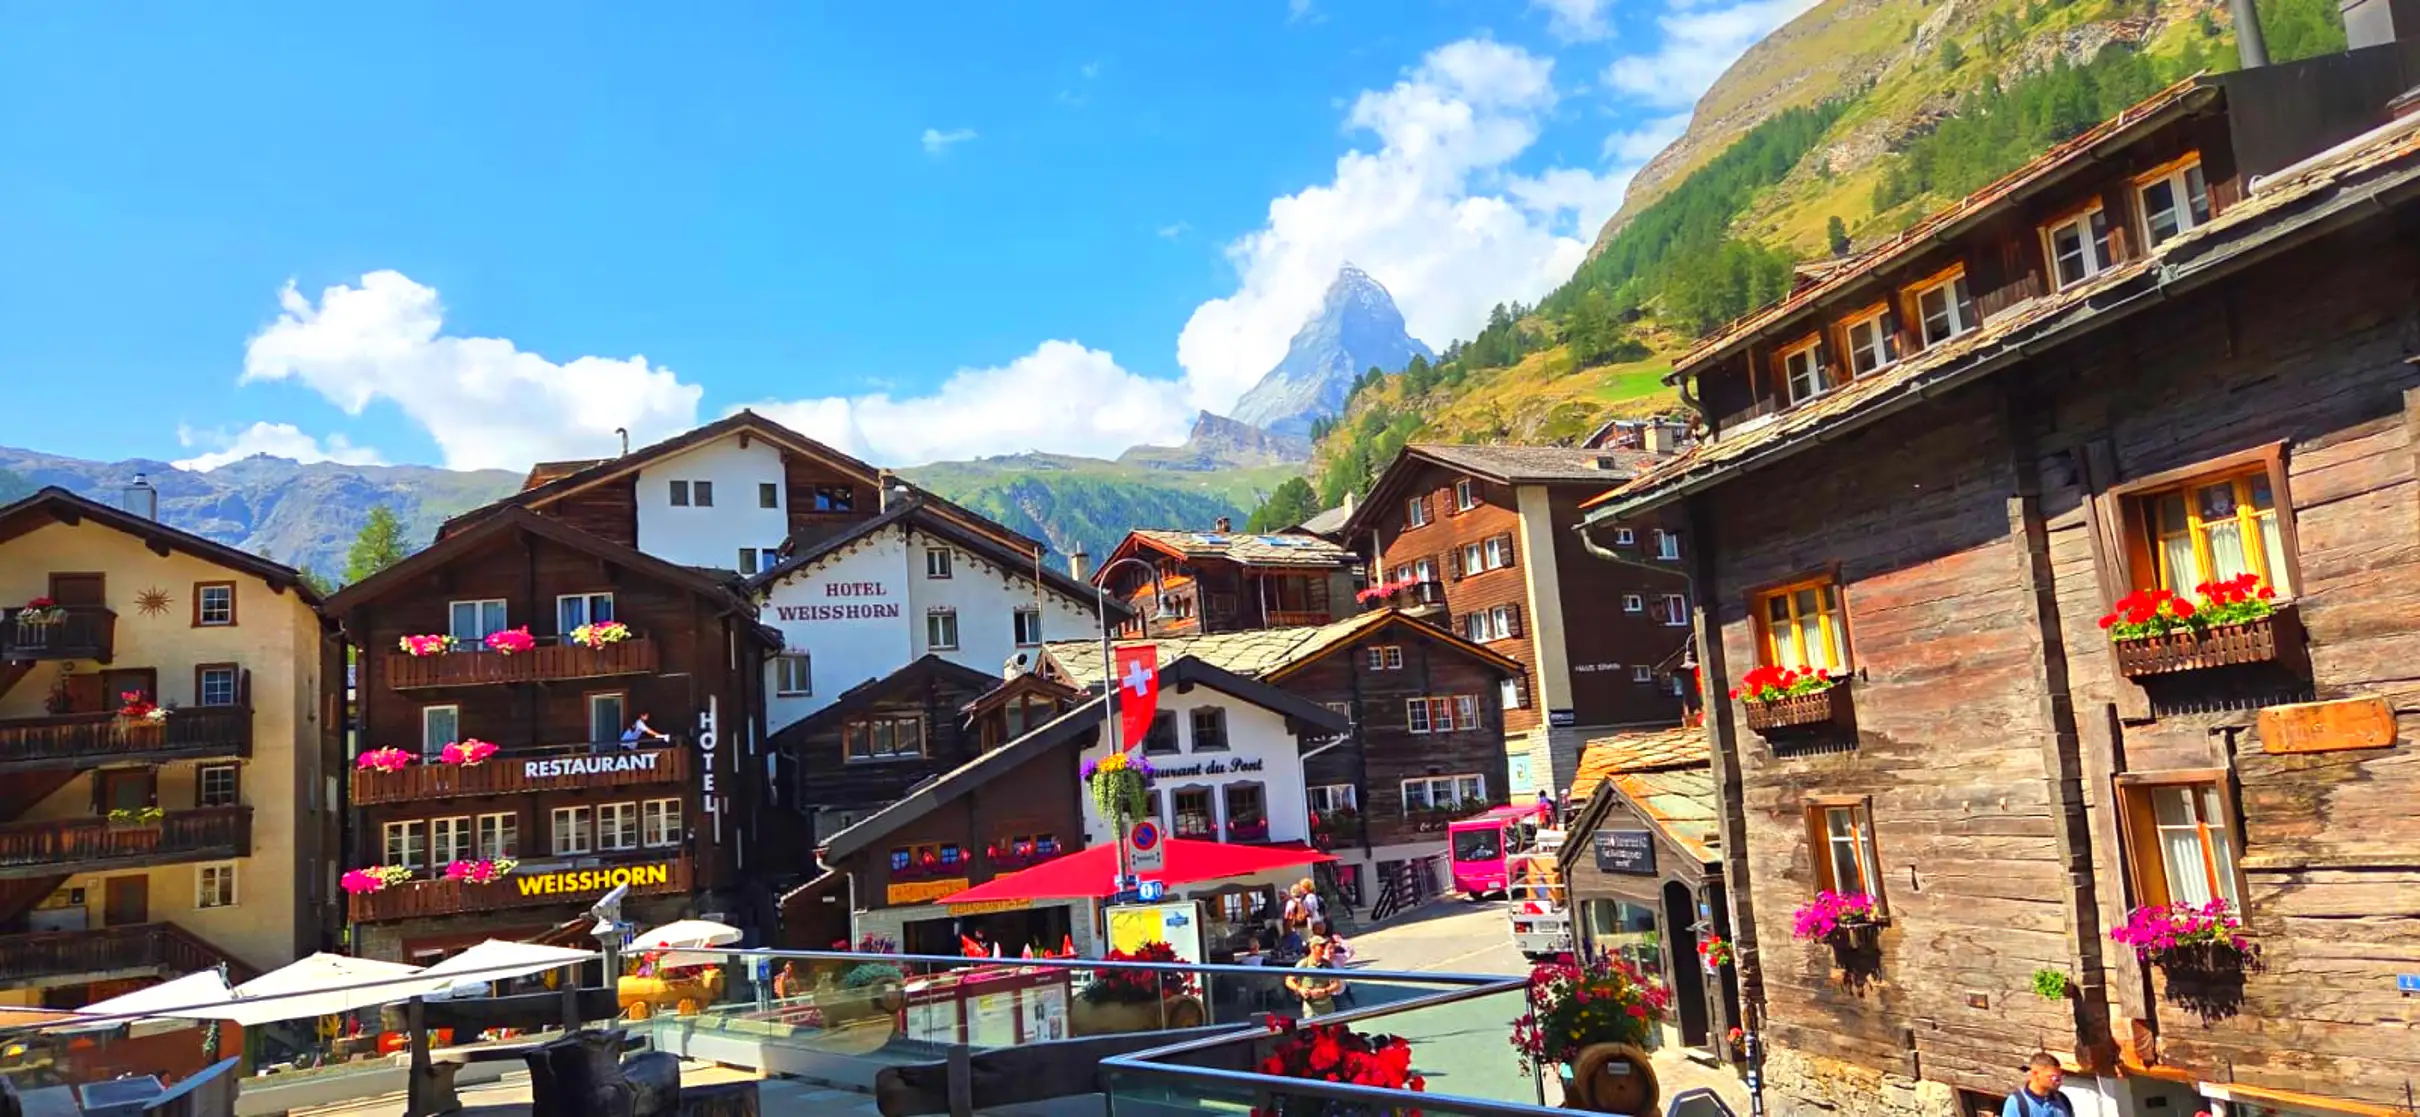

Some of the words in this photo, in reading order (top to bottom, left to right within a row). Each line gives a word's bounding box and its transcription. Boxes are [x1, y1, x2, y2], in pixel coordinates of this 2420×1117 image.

[826, 582, 887, 597] HOTEL
[777, 603, 899, 621] WEISSHORN
[525, 752, 660, 778] RESTAURANT
[700, 711, 717, 812] HOTEL
[1205, 759, 1225, 775] du
[1229, 756, 1263, 773] Pont
[517, 864, 667, 896] WEISSHORN
